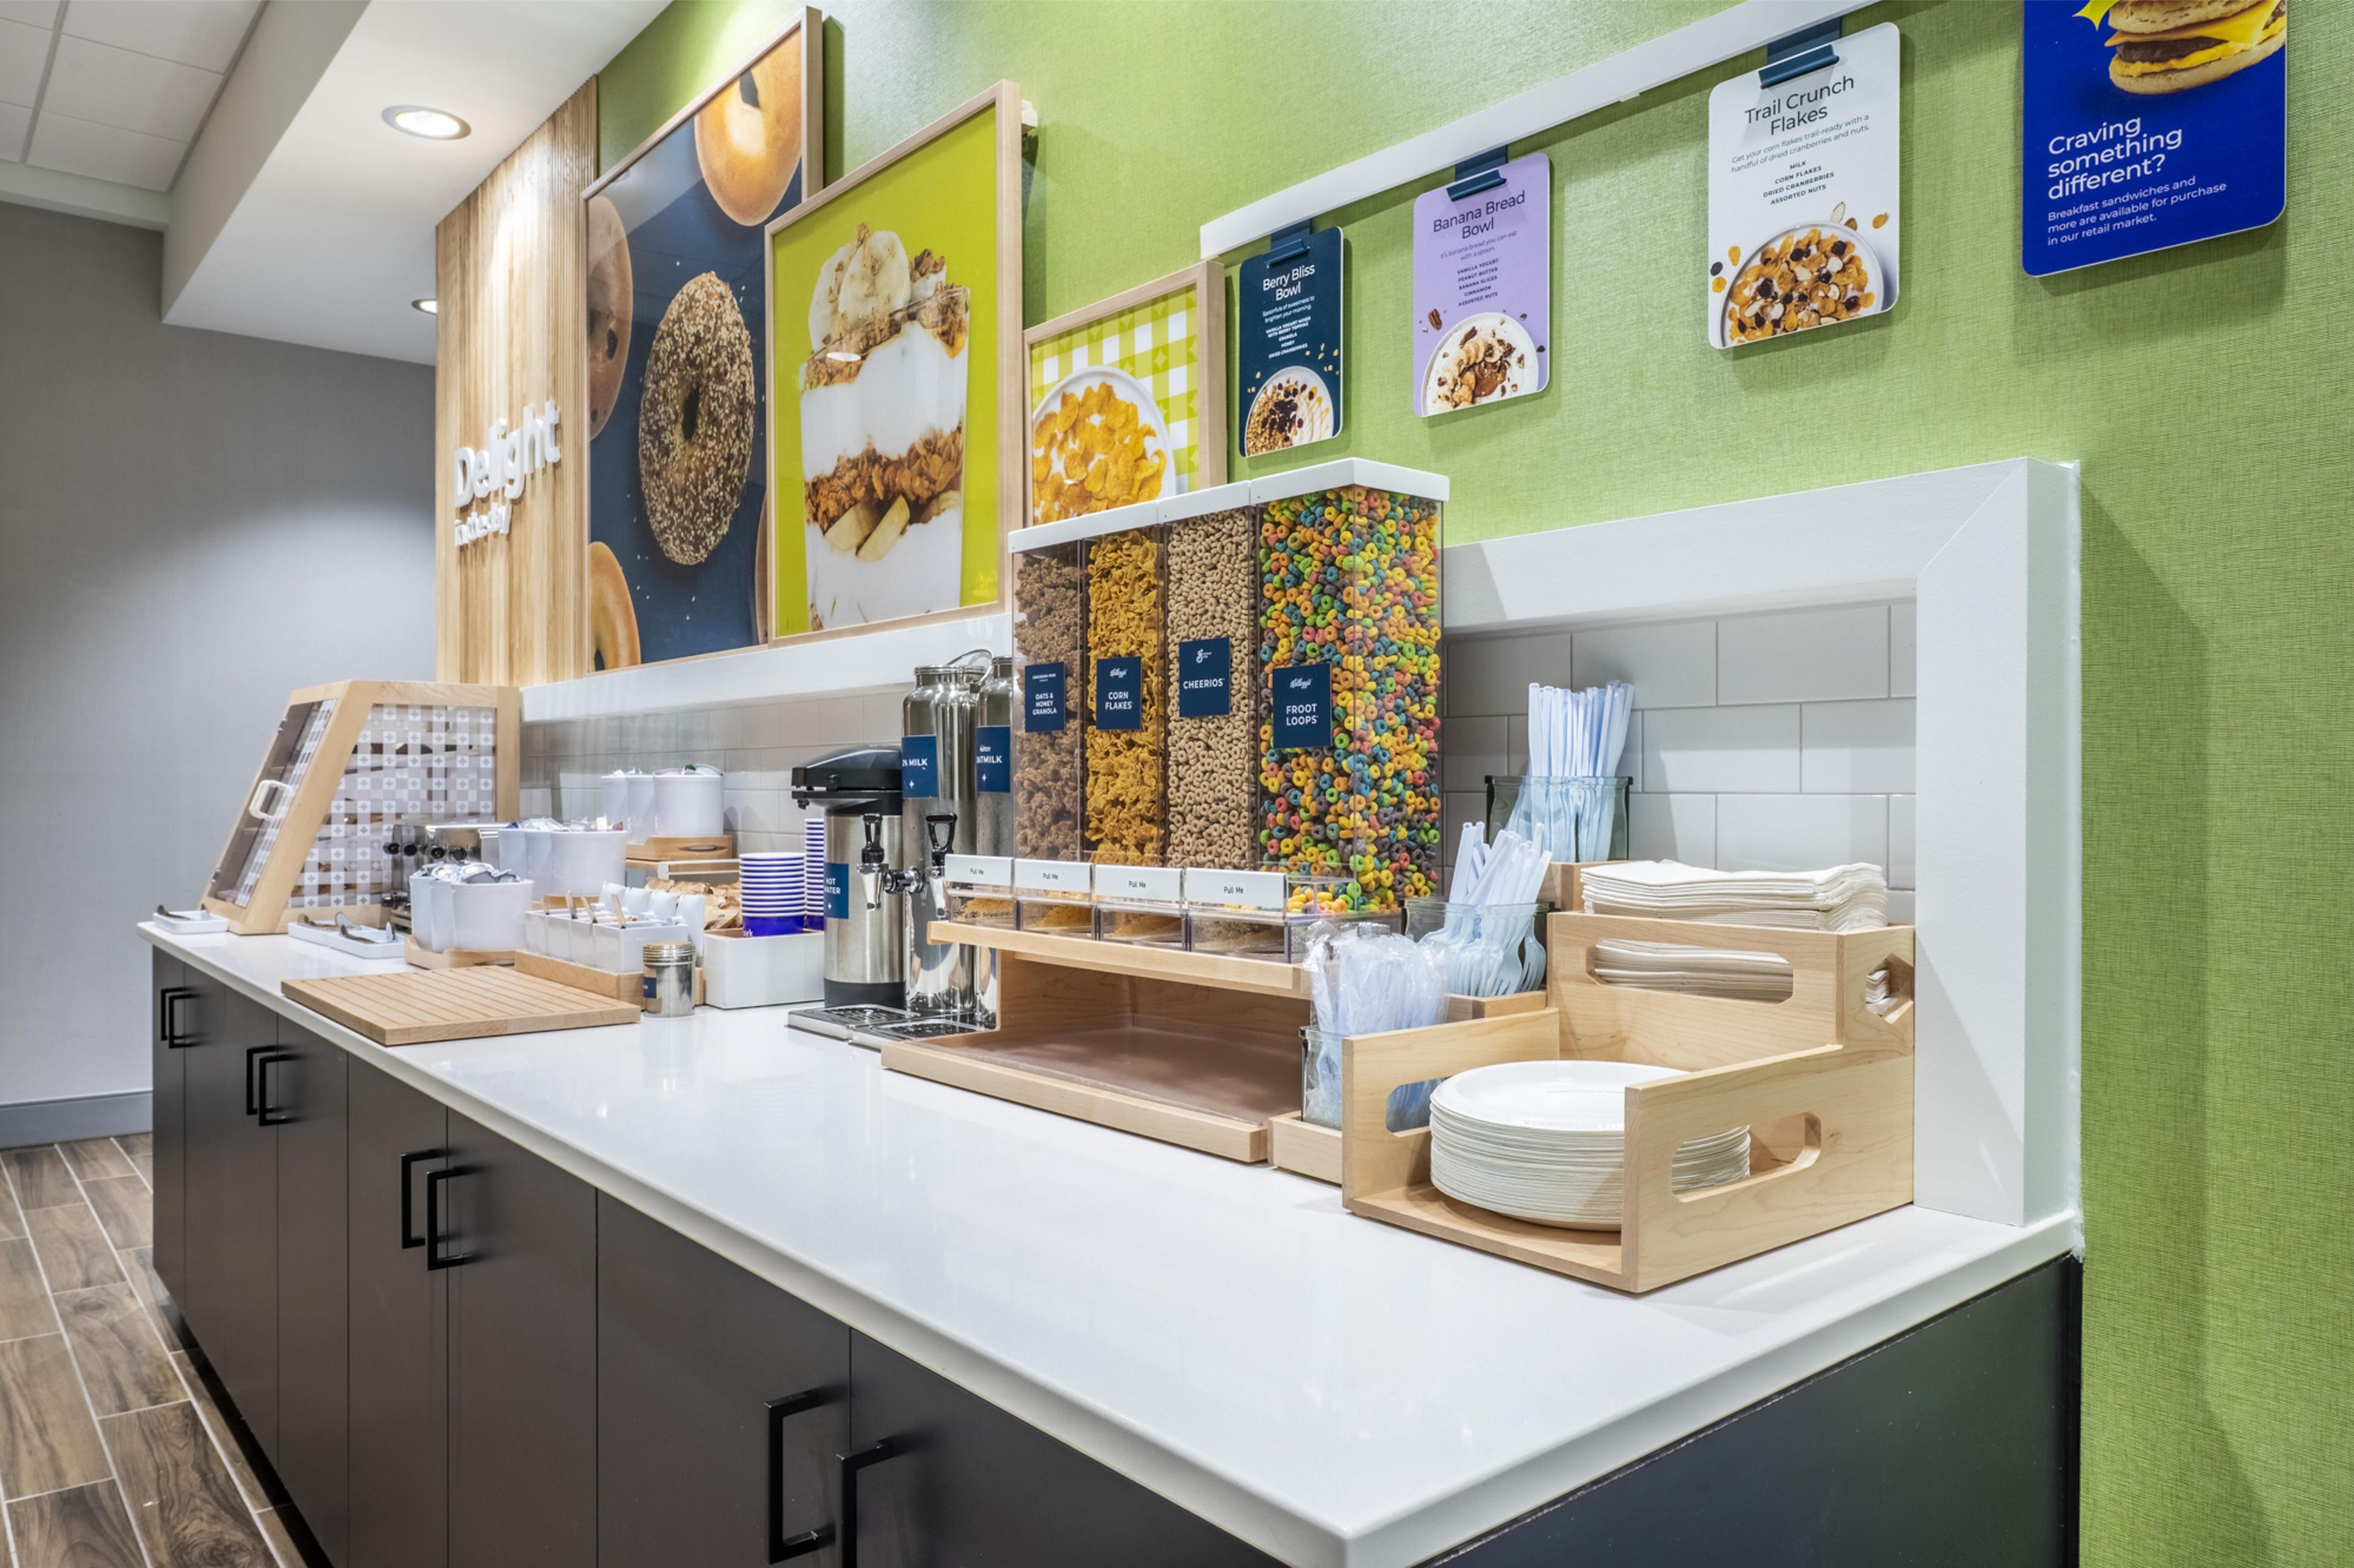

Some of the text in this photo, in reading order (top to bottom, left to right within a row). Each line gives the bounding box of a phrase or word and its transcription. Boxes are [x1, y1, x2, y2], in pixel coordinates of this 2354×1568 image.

[1745, 75, 1854, 124] Trail Crunch
[1770, 106, 1828, 135] Flakes
[1732, 154, 1745, 164] Get
[1745, 149, 1762, 161] your
[1763, 143, 1780, 154] corn
[1781, 136, 1803, 149] flakes
[1804, 123, 1844, 140] trail-ready
[1844, 116, 1863, 127] with
[2048, 117, 2141, 154] Craving
[1731, 124, 1870, 173] handful of dried cranberries and nuts.
[2047, 129, 2183, 178] something
[1775, 165, 1823, 185] CORN FLAKES
[1789, 160, 1807, 170] MILK
[1763, 172, 1835, 198] DRIED CRANBERRIES
[2048, 153, 2166, 200] different?
[1770, 183, 1827, 205] ASSORTED NUTS
[2048, 175, 2196, 221] Breakfast sandwiches and
[1433, 189, 1525, 233] Banana Bread
[2048, 183, 2227, 234] more are available for purchase
[1462, 216, 1495, 239] Bowl
[2047, 213, 2157, 246] in our retail market.
[1448, 246, 1469, 257] banana
[1469, 240, 1485, 250] bread
[1485, 237, 1496, 246] you
[1457, 257, 1499, 275] VANILLA YOGURT
[1458, 266, 1498, 283] PEANUT BUTTER
[1263, 264, 1316, 291] Berry Bliss
[1458, 275, 1497, 291] BANANA SLICES
[1276, 281, 1301, 301] Bowl
[1458, 291, 1498, 307] ASSORTED NUTS
[1464, 286, 1491, 297] CINNAMON
[1183, 677, 1224, 690] CHEERIOS
[1105, 701, 1133, 710] FLAKES
[1108, 691, 1129, 701] CORN
[1032, 707, 1057, 716] GRANOLA
[1286, 703, 1317, 715] FROOT
[1286, 715, 1318, 726] LOOPS
[909, 758, 929, 767] MILK
